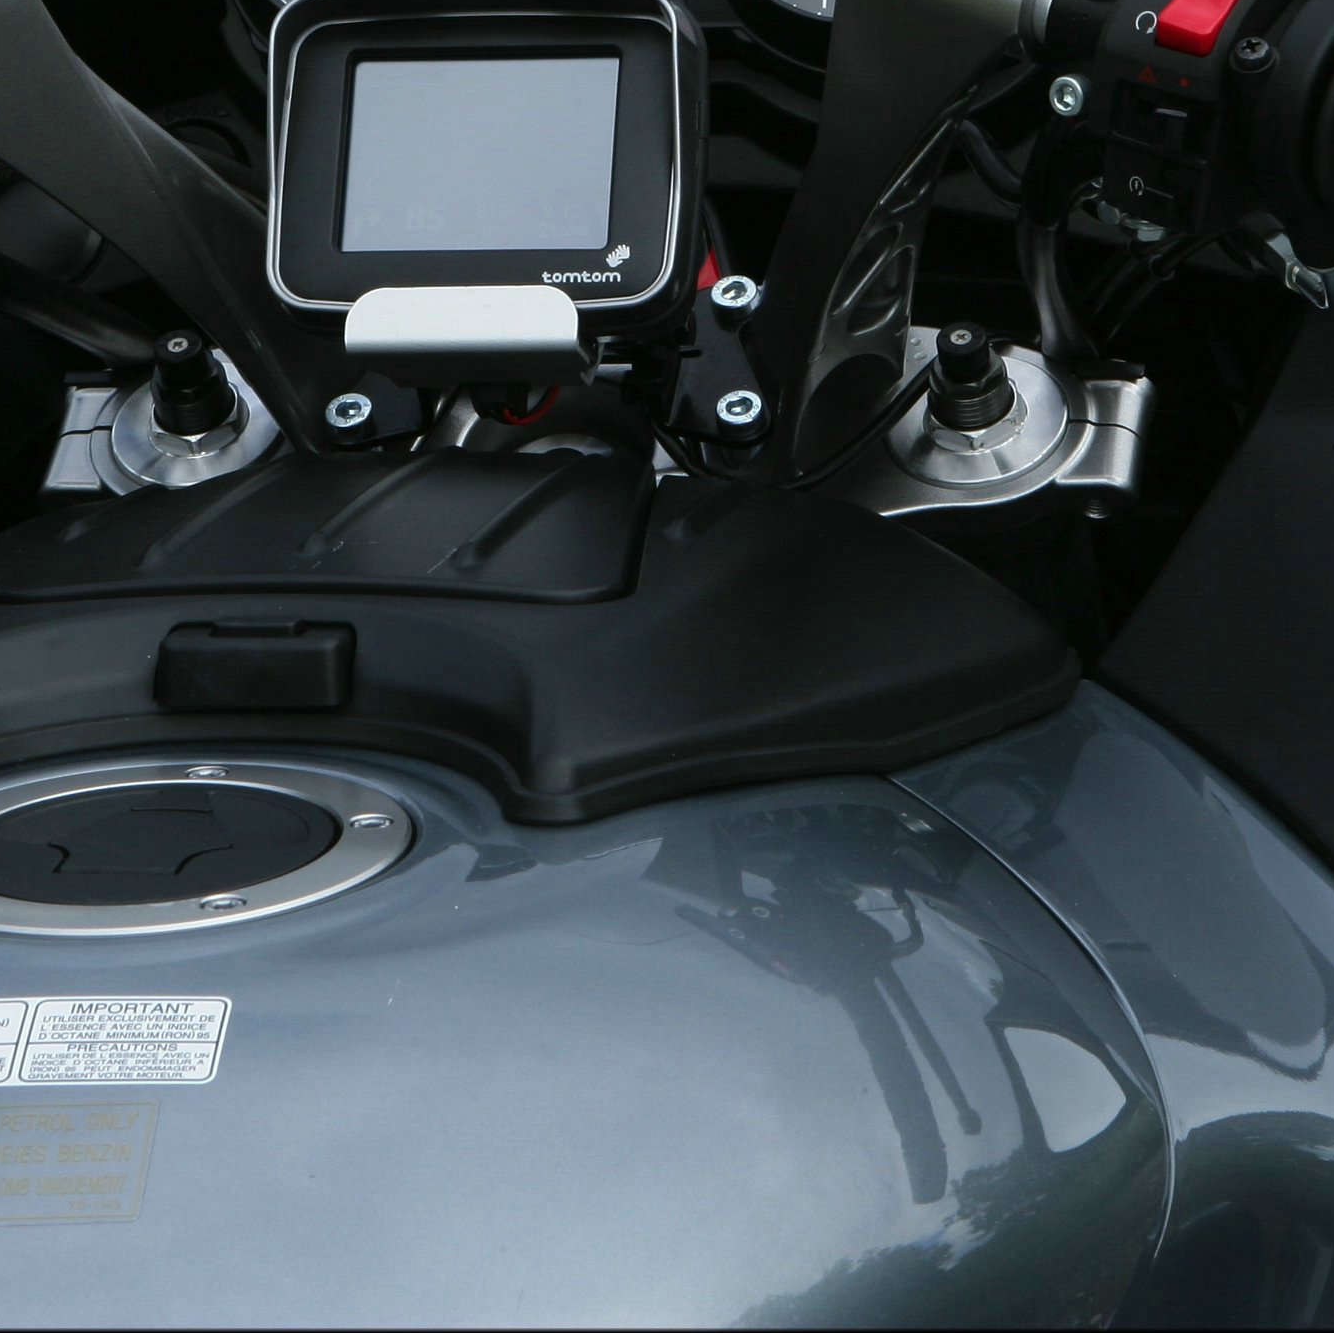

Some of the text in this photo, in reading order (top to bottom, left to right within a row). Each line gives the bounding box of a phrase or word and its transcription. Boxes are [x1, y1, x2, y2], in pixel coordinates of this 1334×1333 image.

[541, 270, 622, 283] tomtom
[70, 1002, 194, 1015] IMPORTANT
[42, 1014, 216, 1024] UTILISER EXCLUSIVEMENT DE
[110, 1023, 142, 1032] AVEC
[145, 1023, 163, 1032] UN
[167, 1023, 207, 1032] INDICE
[85, 1112, 141, 1131] ONLY
[56, 1143, 134, 1163] BENZIN
